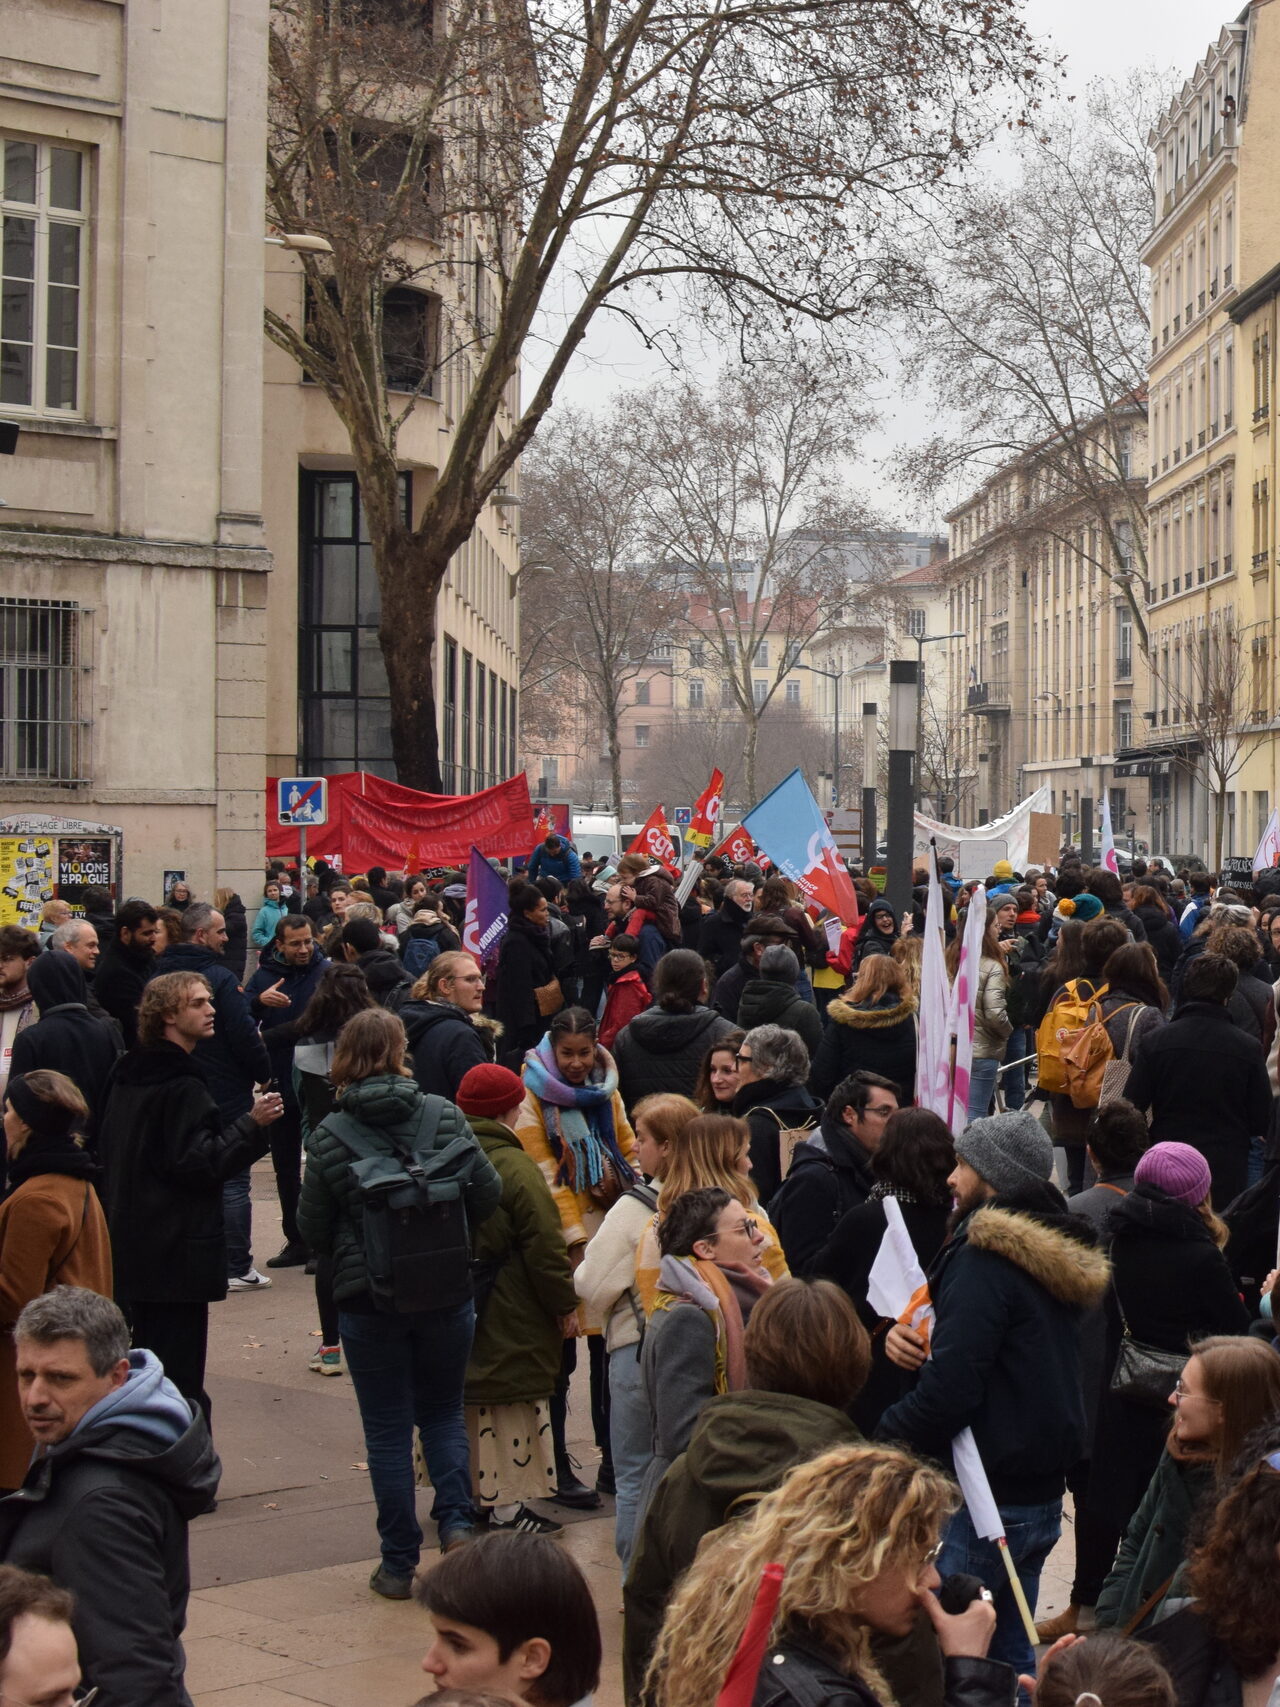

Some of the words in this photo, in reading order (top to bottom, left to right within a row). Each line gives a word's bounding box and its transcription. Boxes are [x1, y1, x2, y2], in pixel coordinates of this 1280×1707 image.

[16, 821, 58, 830] AFFIHAGE
[62, 821, 83, 830] LIBRE
[731, 839, 752, 863] cg
[61, 862, 109, 873] VIOLONS
[61, 873, 68, 884] DE
[69, 873, 109, 884] PRAGUE
